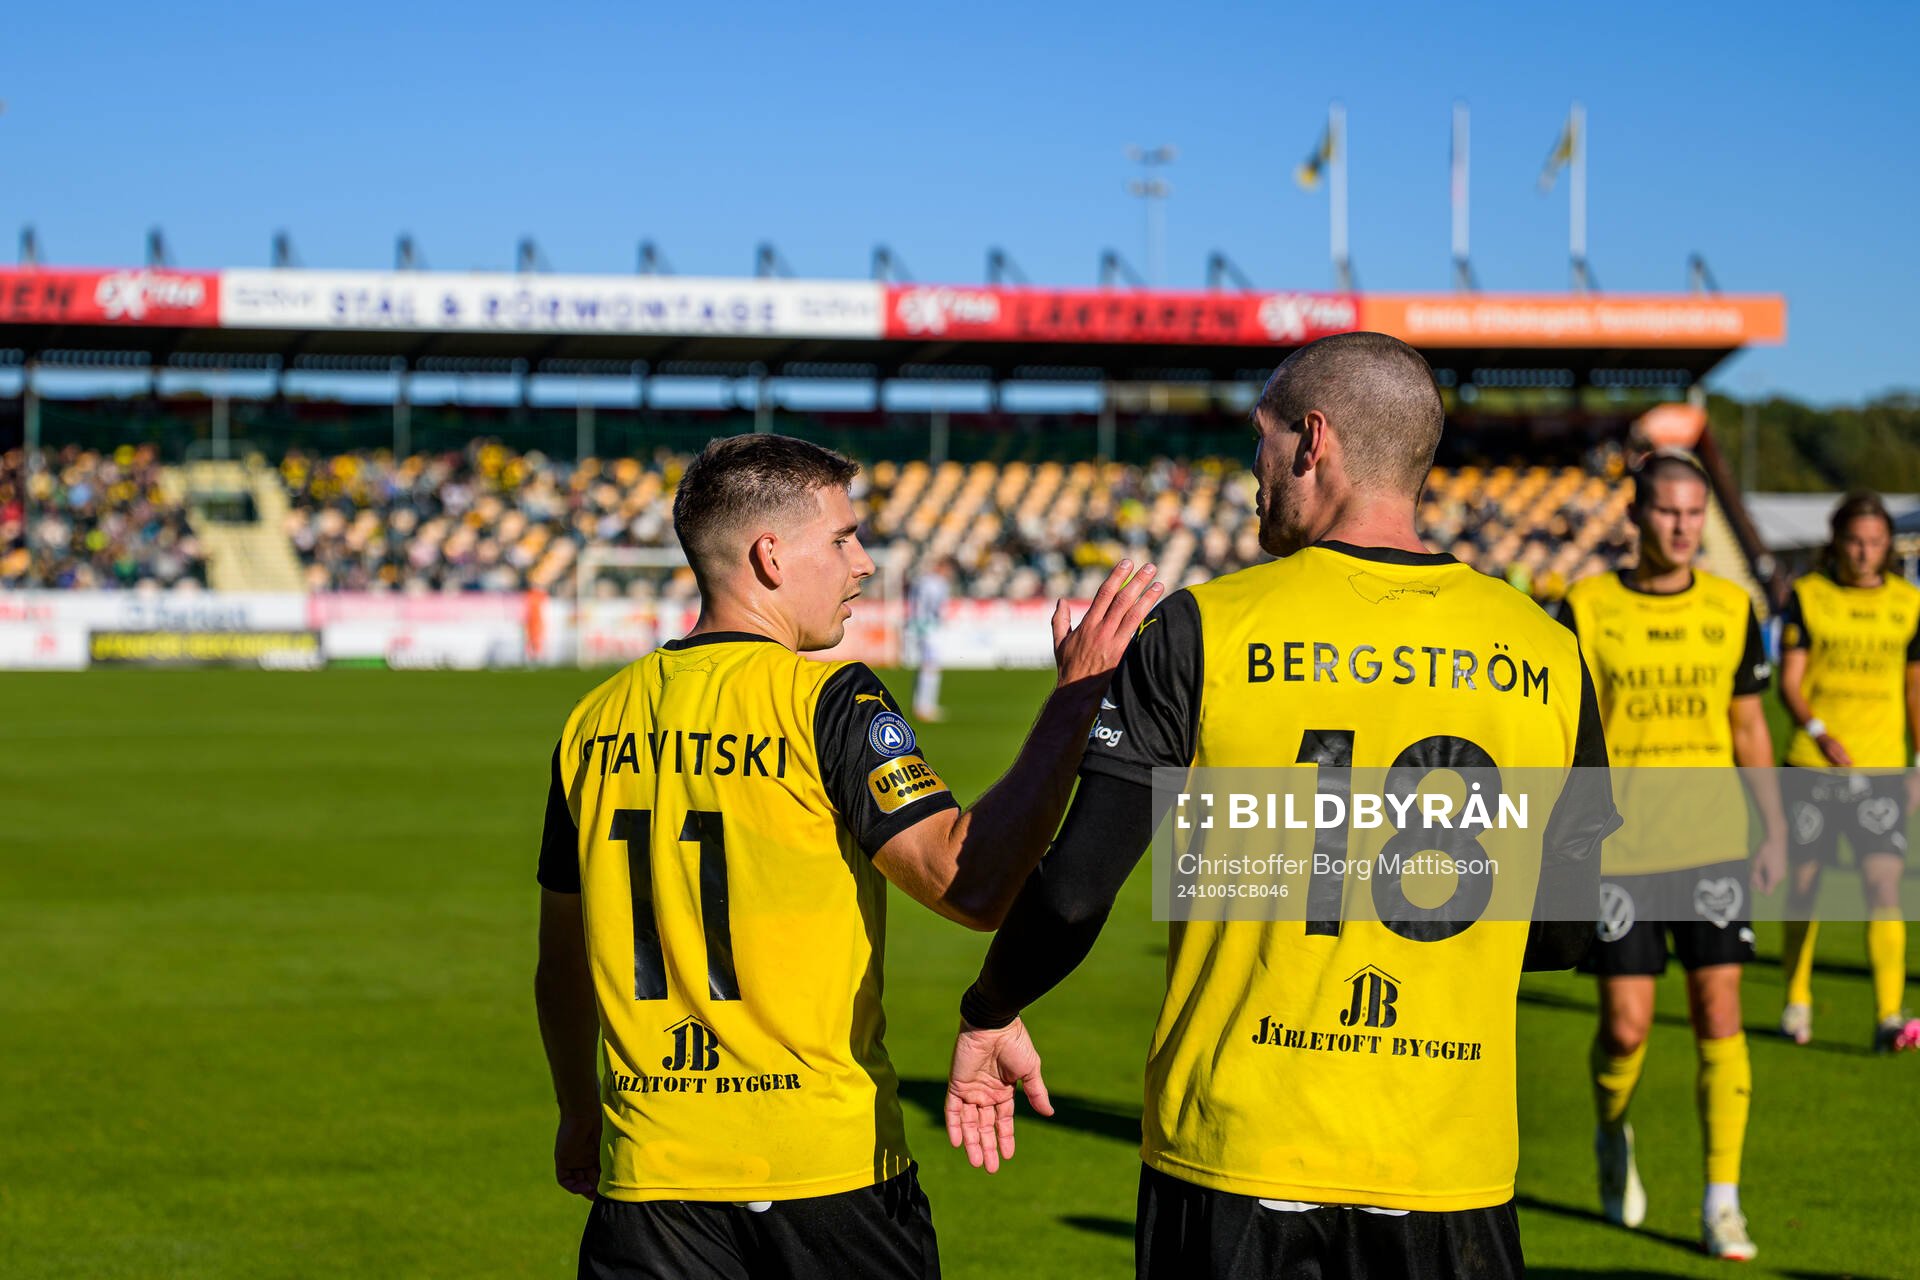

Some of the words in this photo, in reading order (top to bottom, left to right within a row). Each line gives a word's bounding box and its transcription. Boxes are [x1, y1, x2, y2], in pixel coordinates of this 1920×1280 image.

[1247, 642, 1549, 705] BERGSTRÖM
[1295, 728, 1503, 943] 18
[608, 808, 743, 1001] 11
[1251, 1015, 1382, 1054] JÄRLETOFT
[1392, 1037, 1482, 1061] BYGGER
[611, 1070, 707, 1094] RLETOFT
[715, 1073, 801, 1094] BYGGER
